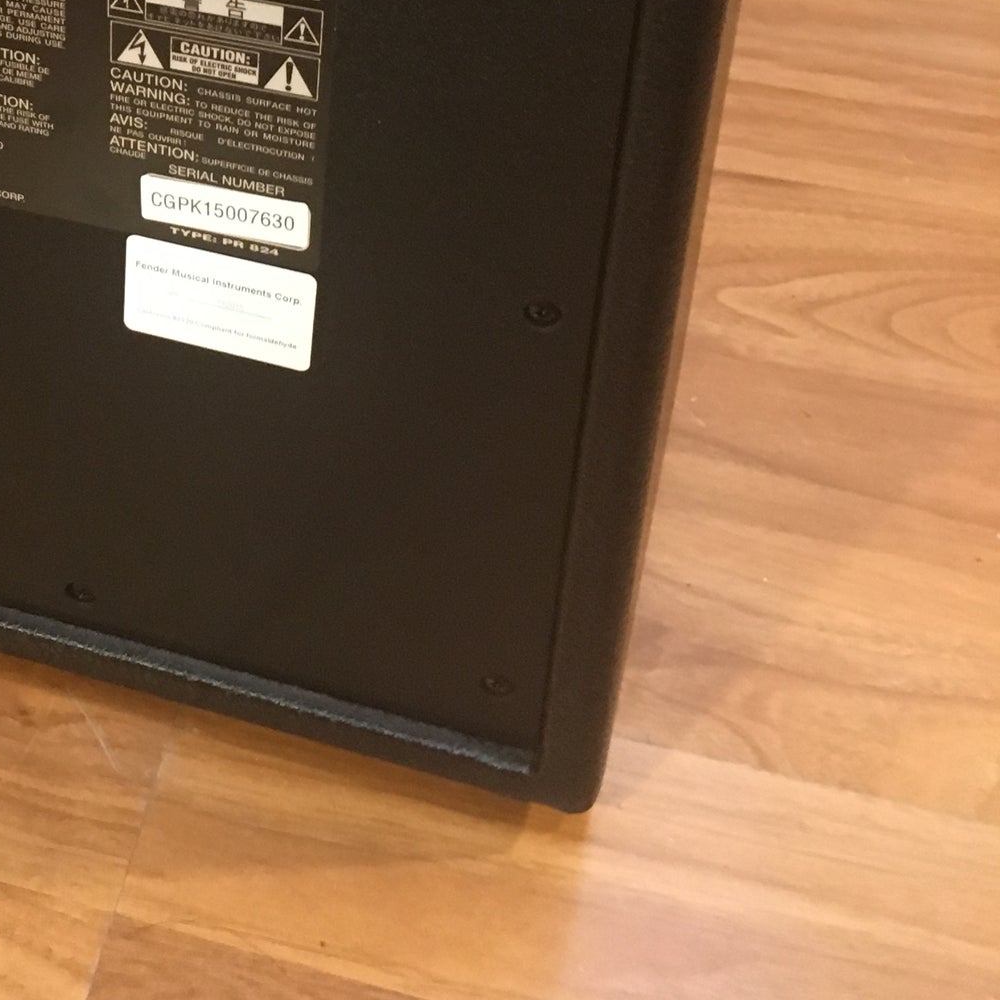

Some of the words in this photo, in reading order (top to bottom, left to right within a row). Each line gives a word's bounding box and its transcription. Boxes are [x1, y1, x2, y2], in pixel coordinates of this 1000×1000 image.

[172, 54, 187, 63] RISK
[189, 57, 198, 65] OF
[200, 59, 232, 71] ELECTRIC
[234, 66, 256, 76] SHOCK
[180, 41, 250, 65] CAUTION:
[192, 65, 201, 73] DO
[203, 67, 217, 76] NOT
[219, 70, 235, 79] OPEN
[110, 66, 187, 92] CAUTION:
[197, 86, 241, 102] CHASSIS
[245, 96, 291, 112] SURFACE
[296, 105, 317, 117] HOT
[110, 79, 190, 106] WARNING:
[195, 100, 207, 109] TO
[211, 103, 250, 117] REDUCE
[254, 111, 272, 122] THE
[277, 116, 299, 127] RISK
[303, 121, 316, 130] OF
[110, 111, 147, 130] AVIS:
[110, 134, 198, 163] ATTENTION:
[168, 163, 217, 183] SERIAL
[222, 174, 284, 197] NUMBER
[151, 191, 295, 232] CGPK15007630
[170, 226, 216, 243] TYPE:
[222, 237, 244, 249] PR
[249, 243, 279, 256] 824
[135, 260, 168, 274] Fender
[172, 269, 209, 284] Musical
[212, 278, 271, 298] Instruments
[275, 292, 302, 306] Corp.
